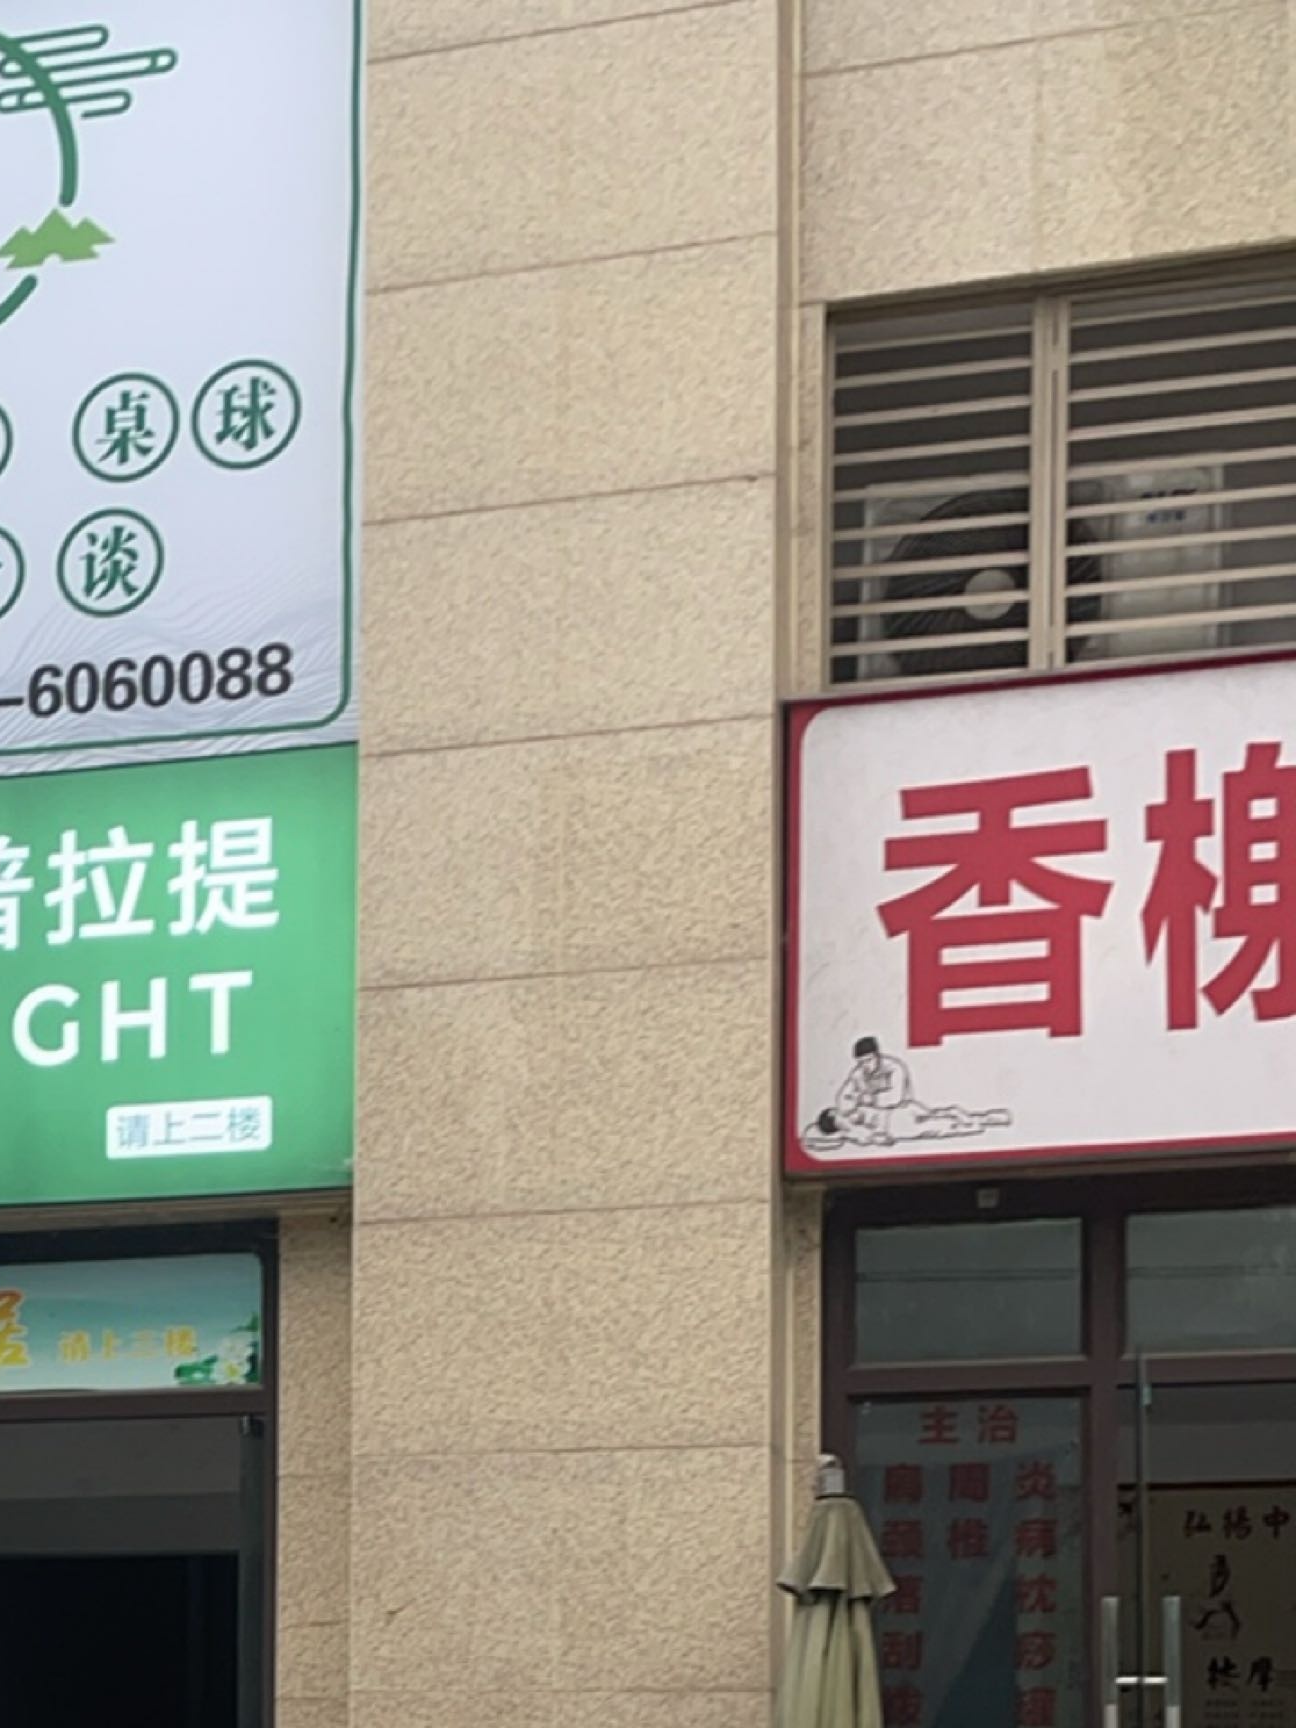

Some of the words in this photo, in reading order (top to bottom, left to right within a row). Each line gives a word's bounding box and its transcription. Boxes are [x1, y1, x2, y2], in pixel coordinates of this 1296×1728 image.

[95, 376, 279, 468] 桌球
[115, 1106, 261, 1149] 请上二楼
[917, 1404, 1019, 1445] 主治
